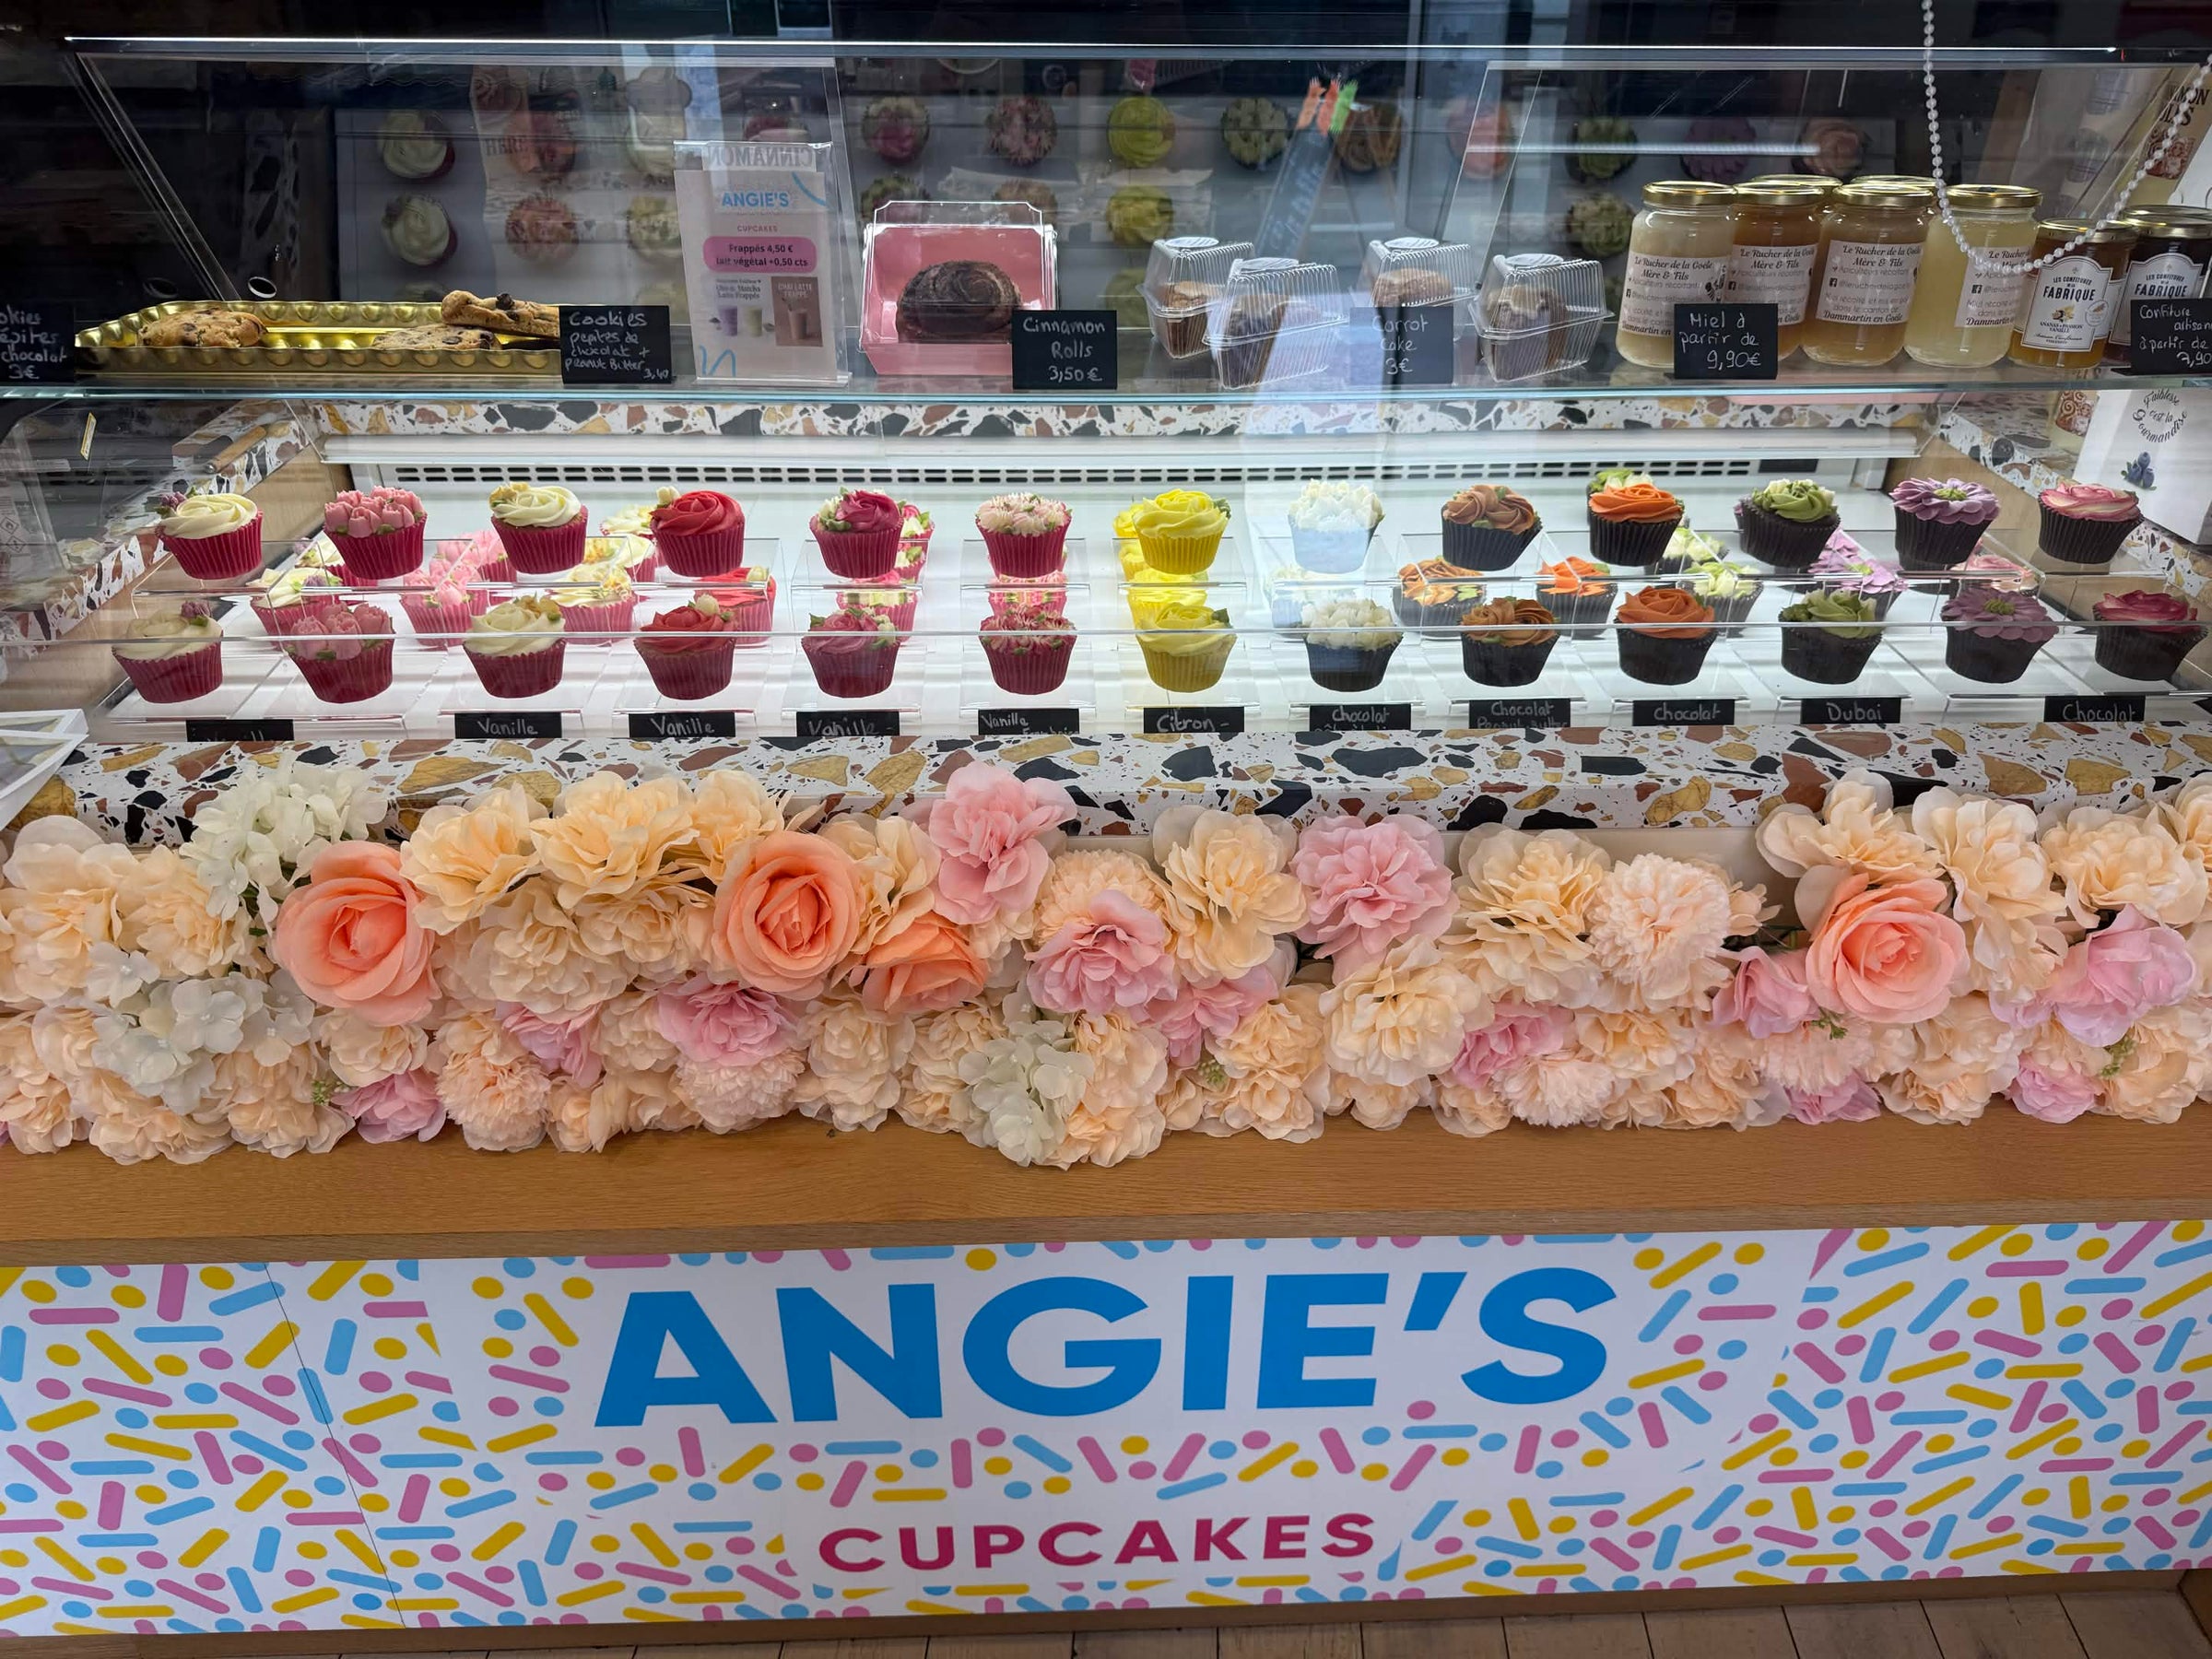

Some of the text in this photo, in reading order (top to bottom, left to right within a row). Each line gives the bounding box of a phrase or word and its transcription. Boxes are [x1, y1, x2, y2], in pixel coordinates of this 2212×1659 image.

[722, 191, 790, 207] ANGIE'S
[729, 243, 794, 254] Frappés 4,50 €
[1752, 248, 1783, 258] Rucher
[1854, 245, 1886, 256] Rucher
[1887, 245, 1897, 255] de
[733, 257, 767, 268] végétal
[794, 258, 807, 266] cts
[1642, 257, 1668, 268] Rucher
[2042, 285, 2096, 302] FABRIQUE
[2134, 283, 2188, 299] FABRIQUE
[569, 311, 647, 327] Cookies
[1689, 310, 1725, 328] Miel
[1824, 310, 1871, 322] Dammartin
[2139, 303, 2192, 319] Confiture
[1022, 316, 1106, 335] Cinnamon
[1371, 313, 1429, 333] Carrot
[1051, 338, 1094, 359] Rolls
[1678, 328, 1759, 354] partir de
[2191, 335, 2209, 350] de
[1, 344, 67, 363] chocolat
[1707, 349, 1762, 371] 9,90€
[1826, 700, 1882, 721] Dubai
[2063, 700, 2136, 722] Chocolat
[477, 717, 538, 735] Vanille
[651, 716, 715, 736] Vanille
[808, 716, 879, 736] Vanille
[981, 712, 1030, 729] Vanille
[1156, 709, 1216, 734] Citron
[595, 1268, 1617, 1427] ANGIE'S
[818, 1513, 1374, 1572] CUPCAKES
